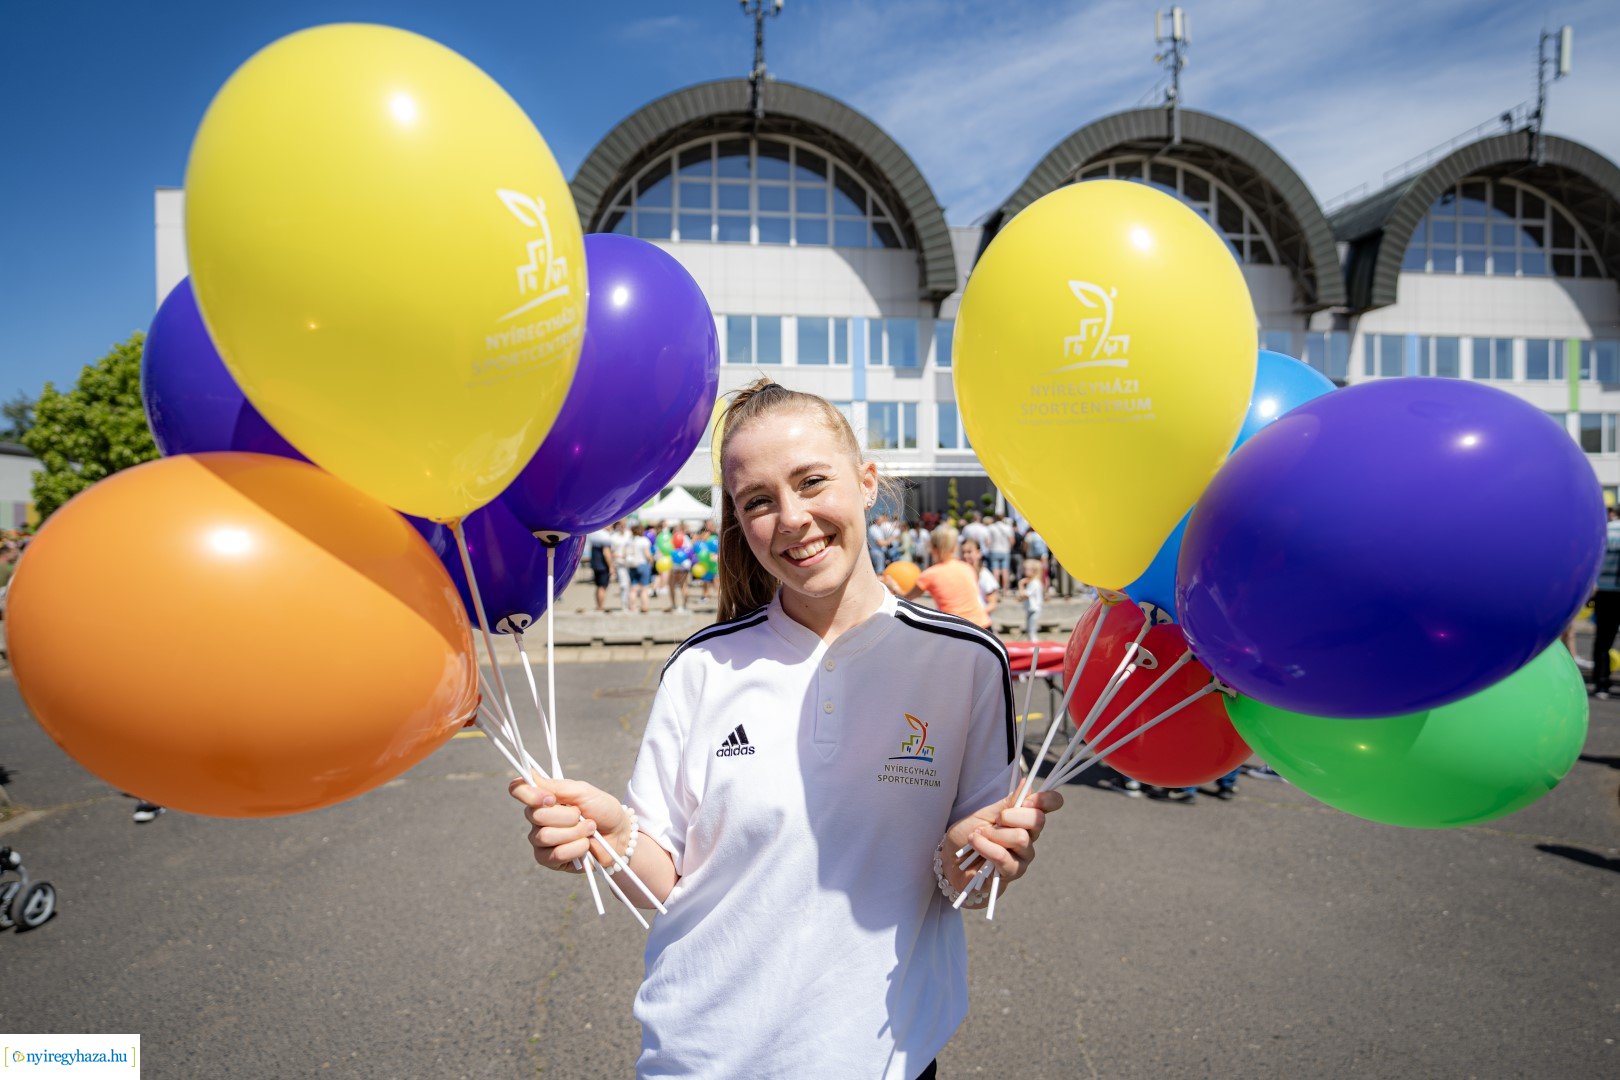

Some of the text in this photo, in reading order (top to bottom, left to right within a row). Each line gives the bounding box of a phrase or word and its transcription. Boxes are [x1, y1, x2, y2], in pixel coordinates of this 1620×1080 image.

[1020, 398, 1152, 416] SPORTCENTRUM
[716, 745, 756, 757] adidas
[884, 764, 937, 777] NYÍREGYHÁZI
[877, 774, 941, 788] SPORTCENTRUM
